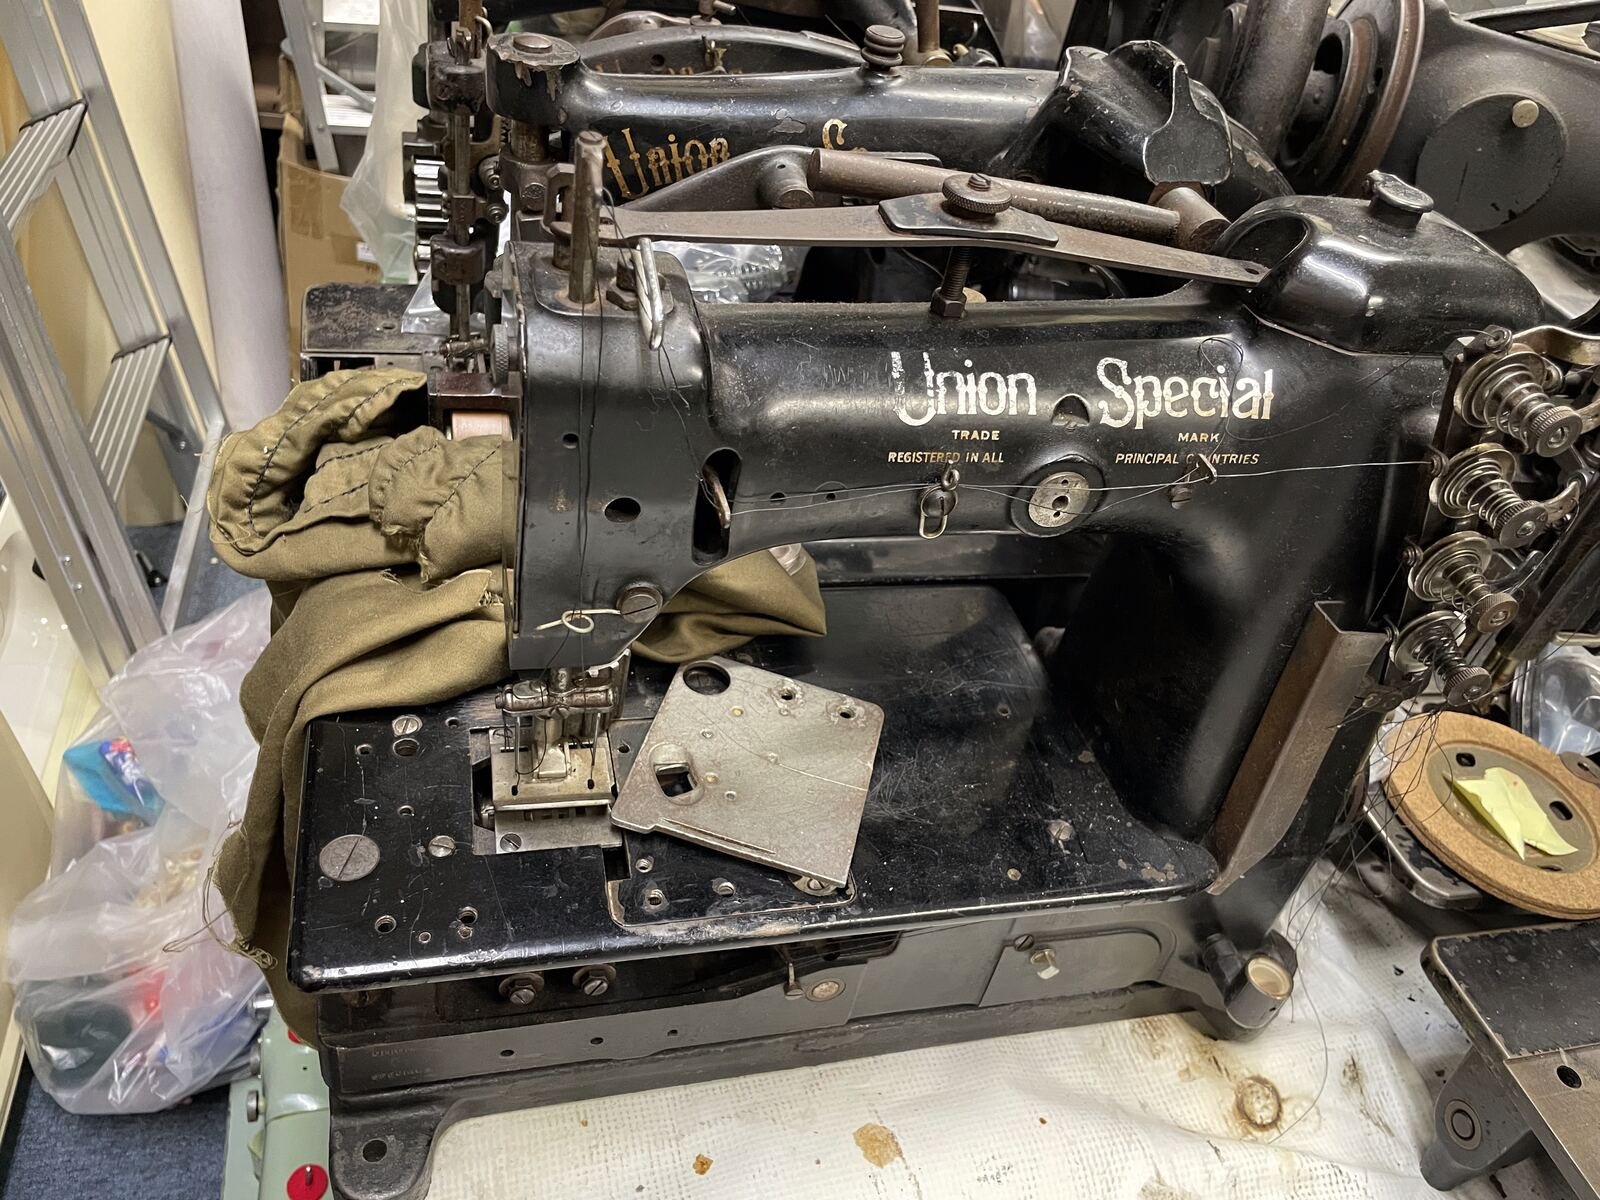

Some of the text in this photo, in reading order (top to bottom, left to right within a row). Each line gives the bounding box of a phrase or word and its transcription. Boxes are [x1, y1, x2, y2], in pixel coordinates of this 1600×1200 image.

[890, 351, 1275, 430] Union Special
[951, 429, 1220, 443] TRADE MARK
[887, 451, 1260, 465] REGISTERED IN ALL PRINCIPAL CNTRIES
